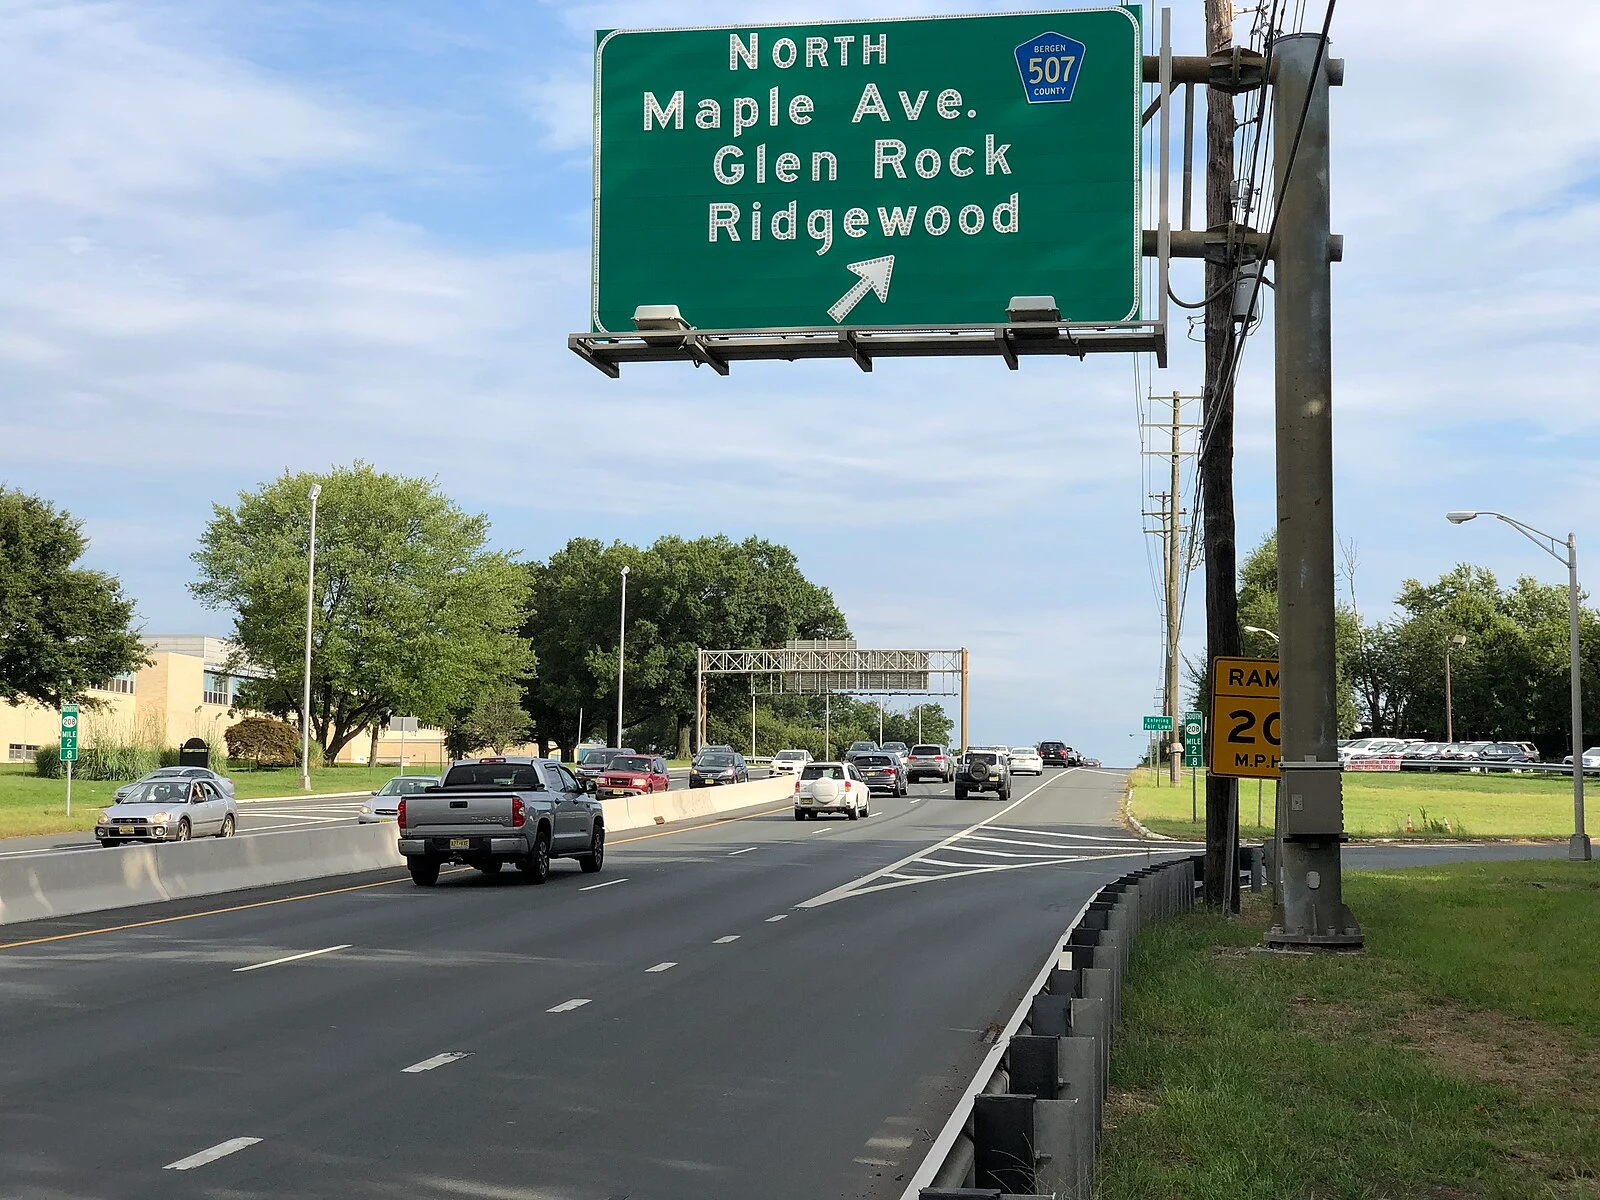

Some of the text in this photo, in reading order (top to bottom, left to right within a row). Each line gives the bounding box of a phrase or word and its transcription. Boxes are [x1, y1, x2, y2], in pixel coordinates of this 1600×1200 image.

[729, 32, 887, 71] NORTH
[1034, 44, 1066, 53] BERGEN
[1028, 55, 1076, 84] 507
[1033, 86, 1067, 96] COUNTY
[643, 82, 977, 138] Maple Ave.
[713, 133, 1012, 185] Glen Rock
[709, 192, 1019, 256] Ridgewood
[1228, 668, 1280, 688] RAM
[1185, 712, 1201, 720] SOUTH
[1187, 725, 1200, 733] 208
[1227, 709, 1281, 746] 20
[66, 739, 72, 747] 2
[1191, 745, 1197, 755] 2
